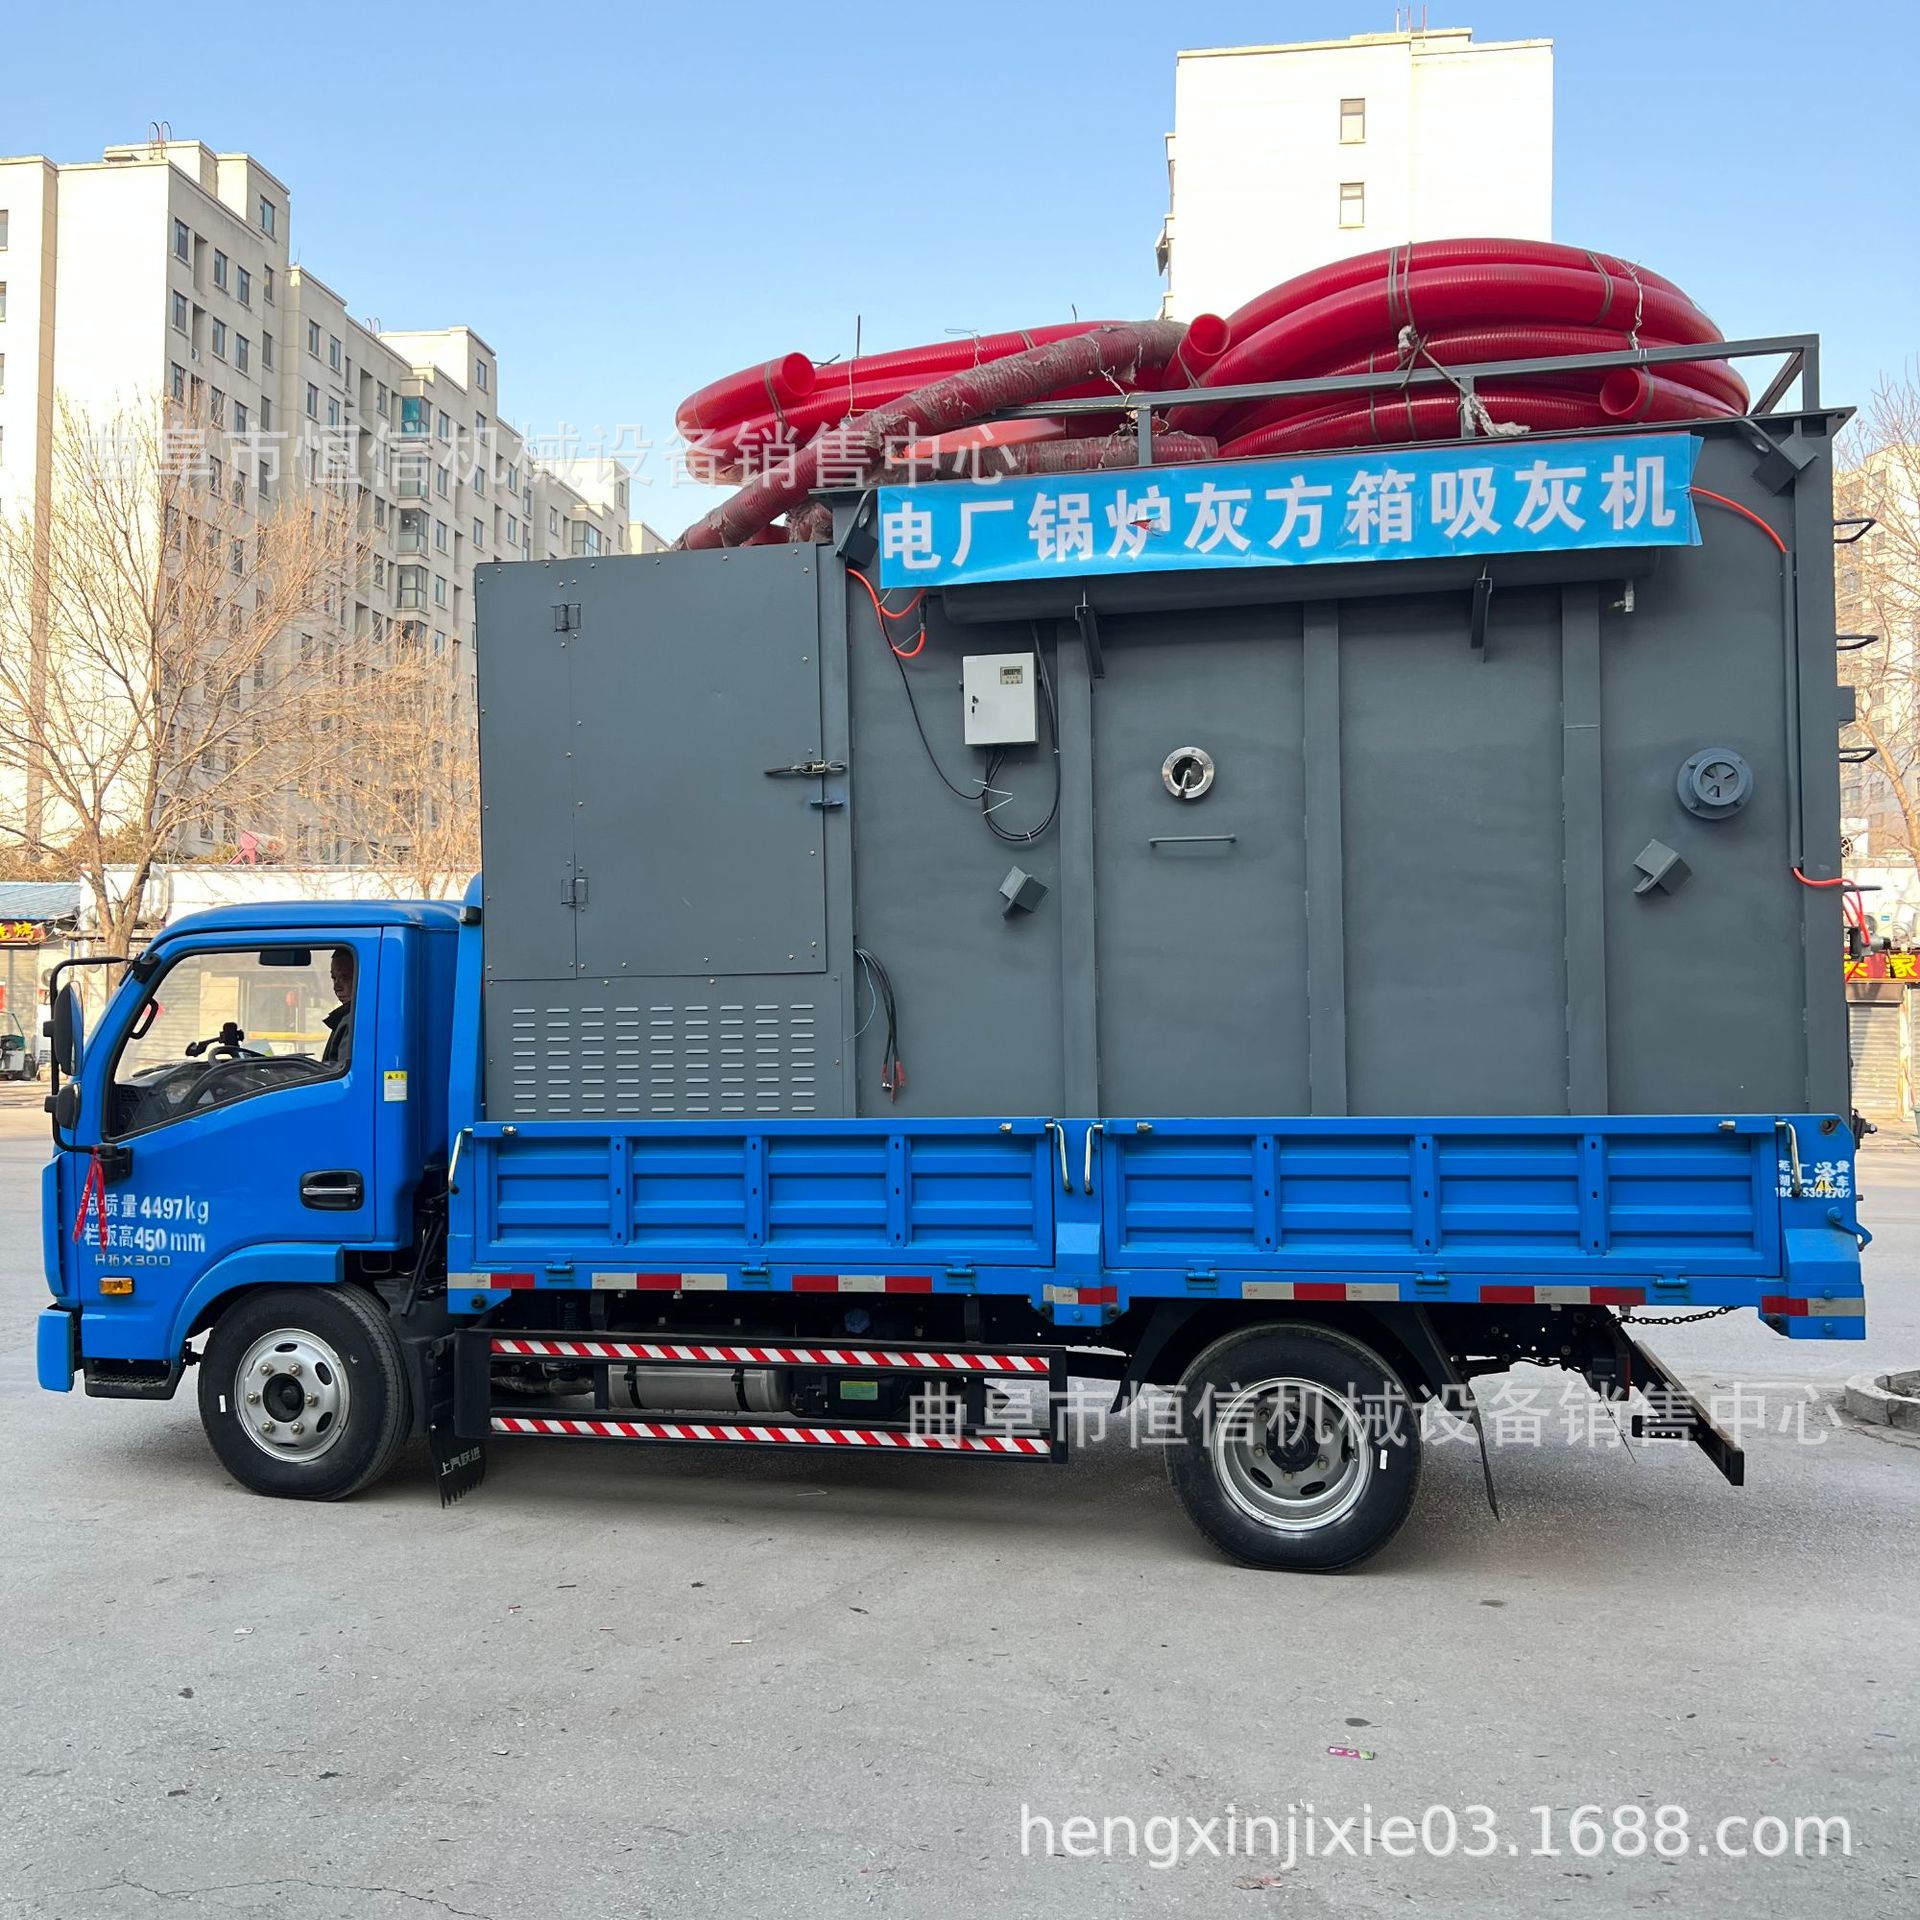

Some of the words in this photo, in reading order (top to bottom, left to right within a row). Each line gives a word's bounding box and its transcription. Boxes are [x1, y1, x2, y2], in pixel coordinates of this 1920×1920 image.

[883, 454, 1676, 569] 电厂锅炉灰方箱吸灰机
